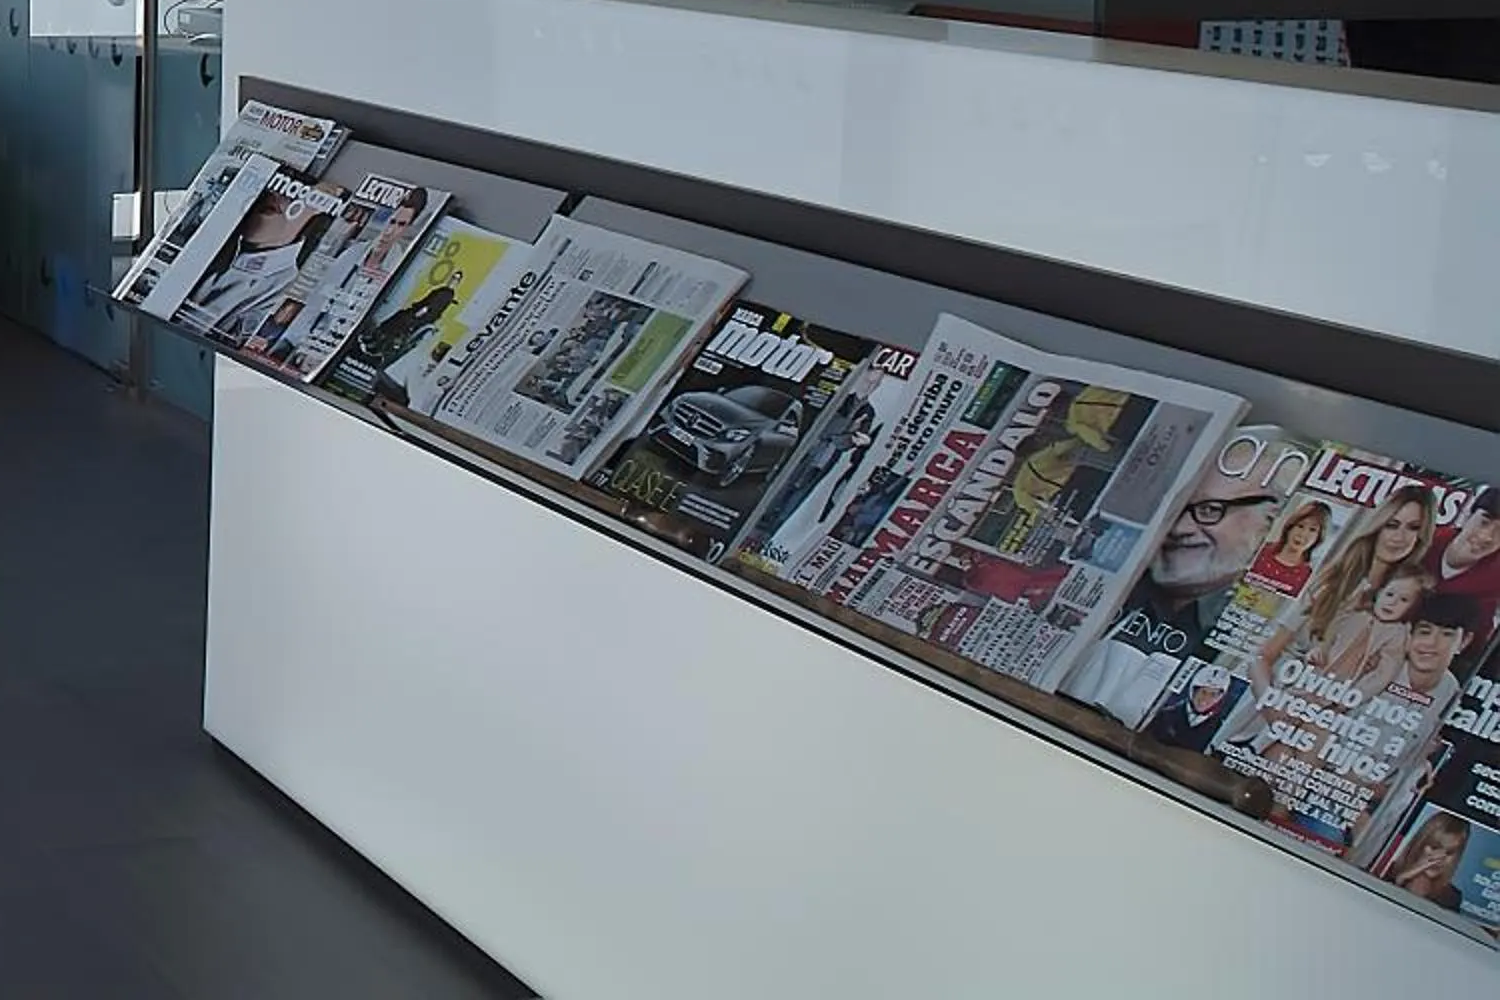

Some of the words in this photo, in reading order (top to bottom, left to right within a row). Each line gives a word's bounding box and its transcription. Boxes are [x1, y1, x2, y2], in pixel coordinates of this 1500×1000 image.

[259, 109, 302, 136] MOTOR
[357, 178, 412, 209] LECTUR
[448, 271, 537, 367] Levante
[705, 318, 834, 383] motor
[871, 346, 916, 377] CAR
[905, 426, 934, 462] otro
[930, 379, 964, 425] muro
[907, 373, 949, 436] derriba
[873, 429, 988, 551] MARCA
[1305, 448, 1467, 526] LECTUS
[1255, 685, 1381, 748] presenta
[1382, 735, 1406, 757] a
[1278, 659, 1363, 709] Olvido
[1364, 695, 1424, 732] nos
[1267, 720, 1318, 752] sus
[1316, 734, 1391, 781] hijos
[1287, 758, 1313, 775] NOS
[1311, 768, 1357, 794] CUENTA
[1305, 778, 1332, 797] CON
